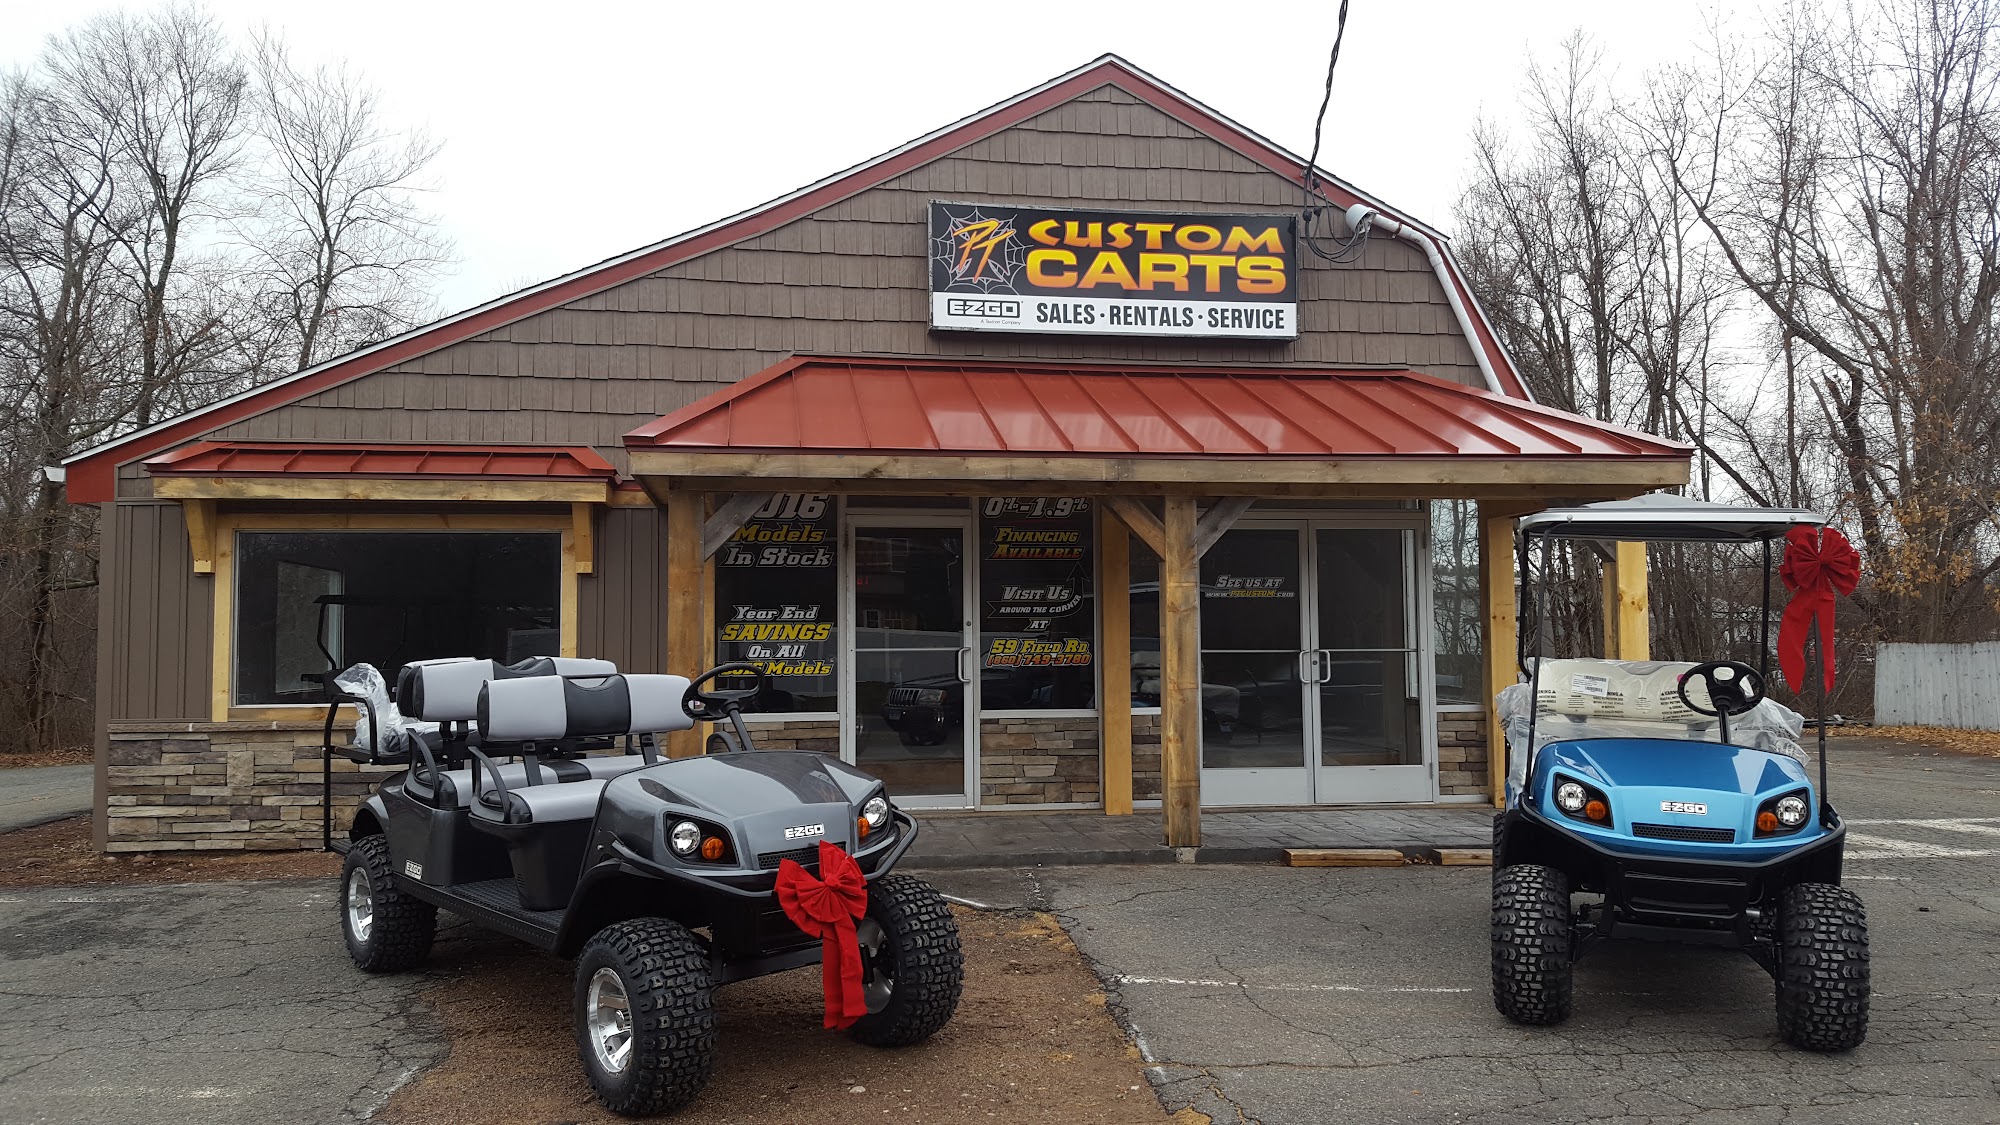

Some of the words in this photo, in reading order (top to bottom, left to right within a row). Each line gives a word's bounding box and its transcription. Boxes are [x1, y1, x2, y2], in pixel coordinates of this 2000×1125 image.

[1028, 219, 1285, 253] CUSTOM
[1026, 249, 1286, 294] CARTS
[1036, 302, 1095, 325] SALES
[1109, 303, 1194, 327] RENTALS
[1207, 308, 1285, 330] SERVICE
[731, 525, 825, 542] Models
[725, 548, 752, 564] In
[759, 547, 832, 564] Stock
[1049, 594, 1081, 613] CORNER
[735, 606, 778, 619] Year
[781, 606, 818, 619] End
[721, 624, 831, 640] SAVINGS
[1030, 620, 1049, 629] AT
[748, 645, 772, 658] On
[776, 645, 805, 658] All
[991, 639, 1018, 653] 59
[765, 661, 831, 675] Models
[987, 654, 1021, 666] (860)
[1024, 654, 1092, 665] 749-3780
